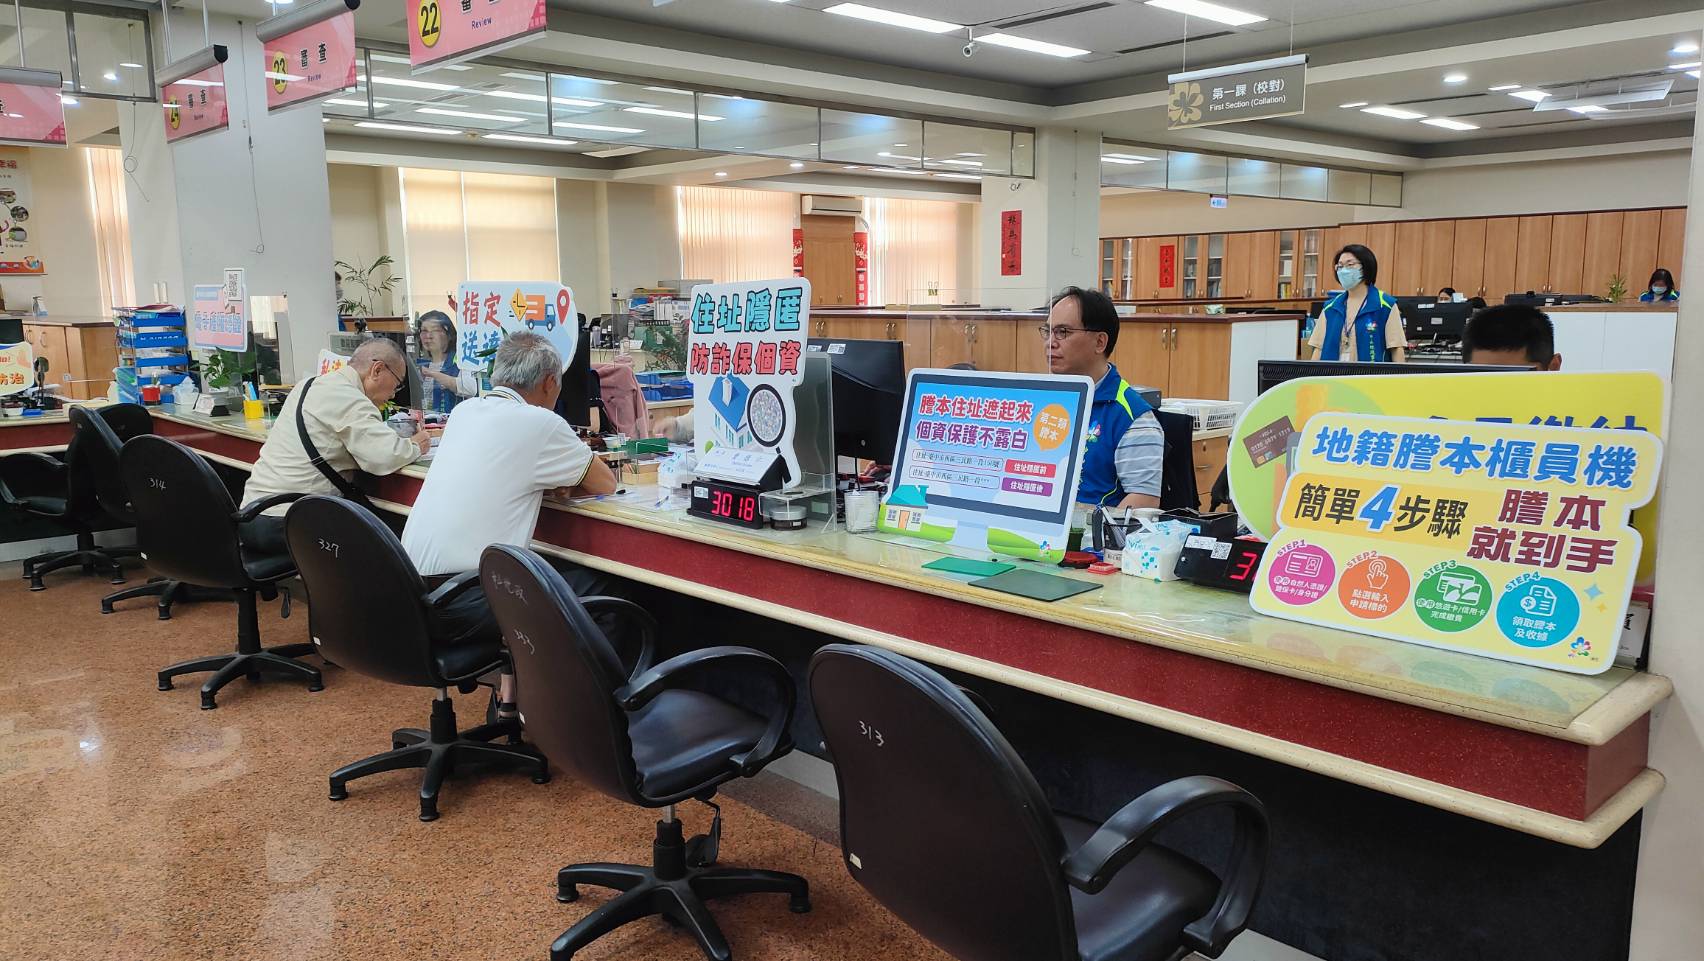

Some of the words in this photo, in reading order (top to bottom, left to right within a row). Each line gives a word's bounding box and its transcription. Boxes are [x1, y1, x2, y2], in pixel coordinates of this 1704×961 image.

[421, 2, 439, 37] 22
[471, 17, 492, 29] Review
[273, 57, 286, 86] 23
[1209, 103, 1224, 111] First
[1225, 100, 1250, 110] Section
[1250, 95, 1286, 108] (Collation)
[463, 291, 501, 328] 指定
[690, 287, 803, 334] 住址隱匿
[690, 340, 801, 375] 防詐保個資
[918, 394, 1033, 423] 謄本住址遮起來
[916, 420, 1028, 450] 個資保護不露白
[1312, 426, 1637, 488] 地籍謄本櫃員機
[149, 477, 167, 490] 314
[711, 490, 755, 522] 3018
[1294, 482, 1469, 539] 簡單4步驟
[1497, 488, 1606, 531] 謄本
[317, 538, 341, 559] 327
[1346, 550, 1378, 568] STEP2
[1467, 525, 1618, 573] 就到手
[1230, 552, 1257, 582] 3
[1424, 559, 1457, 578] STEP3
[1505, 571, 1540, 592] STEP4
[1512, 615, 1557, 631] 領取謄本
[1514, 628, 1549, 642] 及收據
[859, 720, 885, 747] 313
